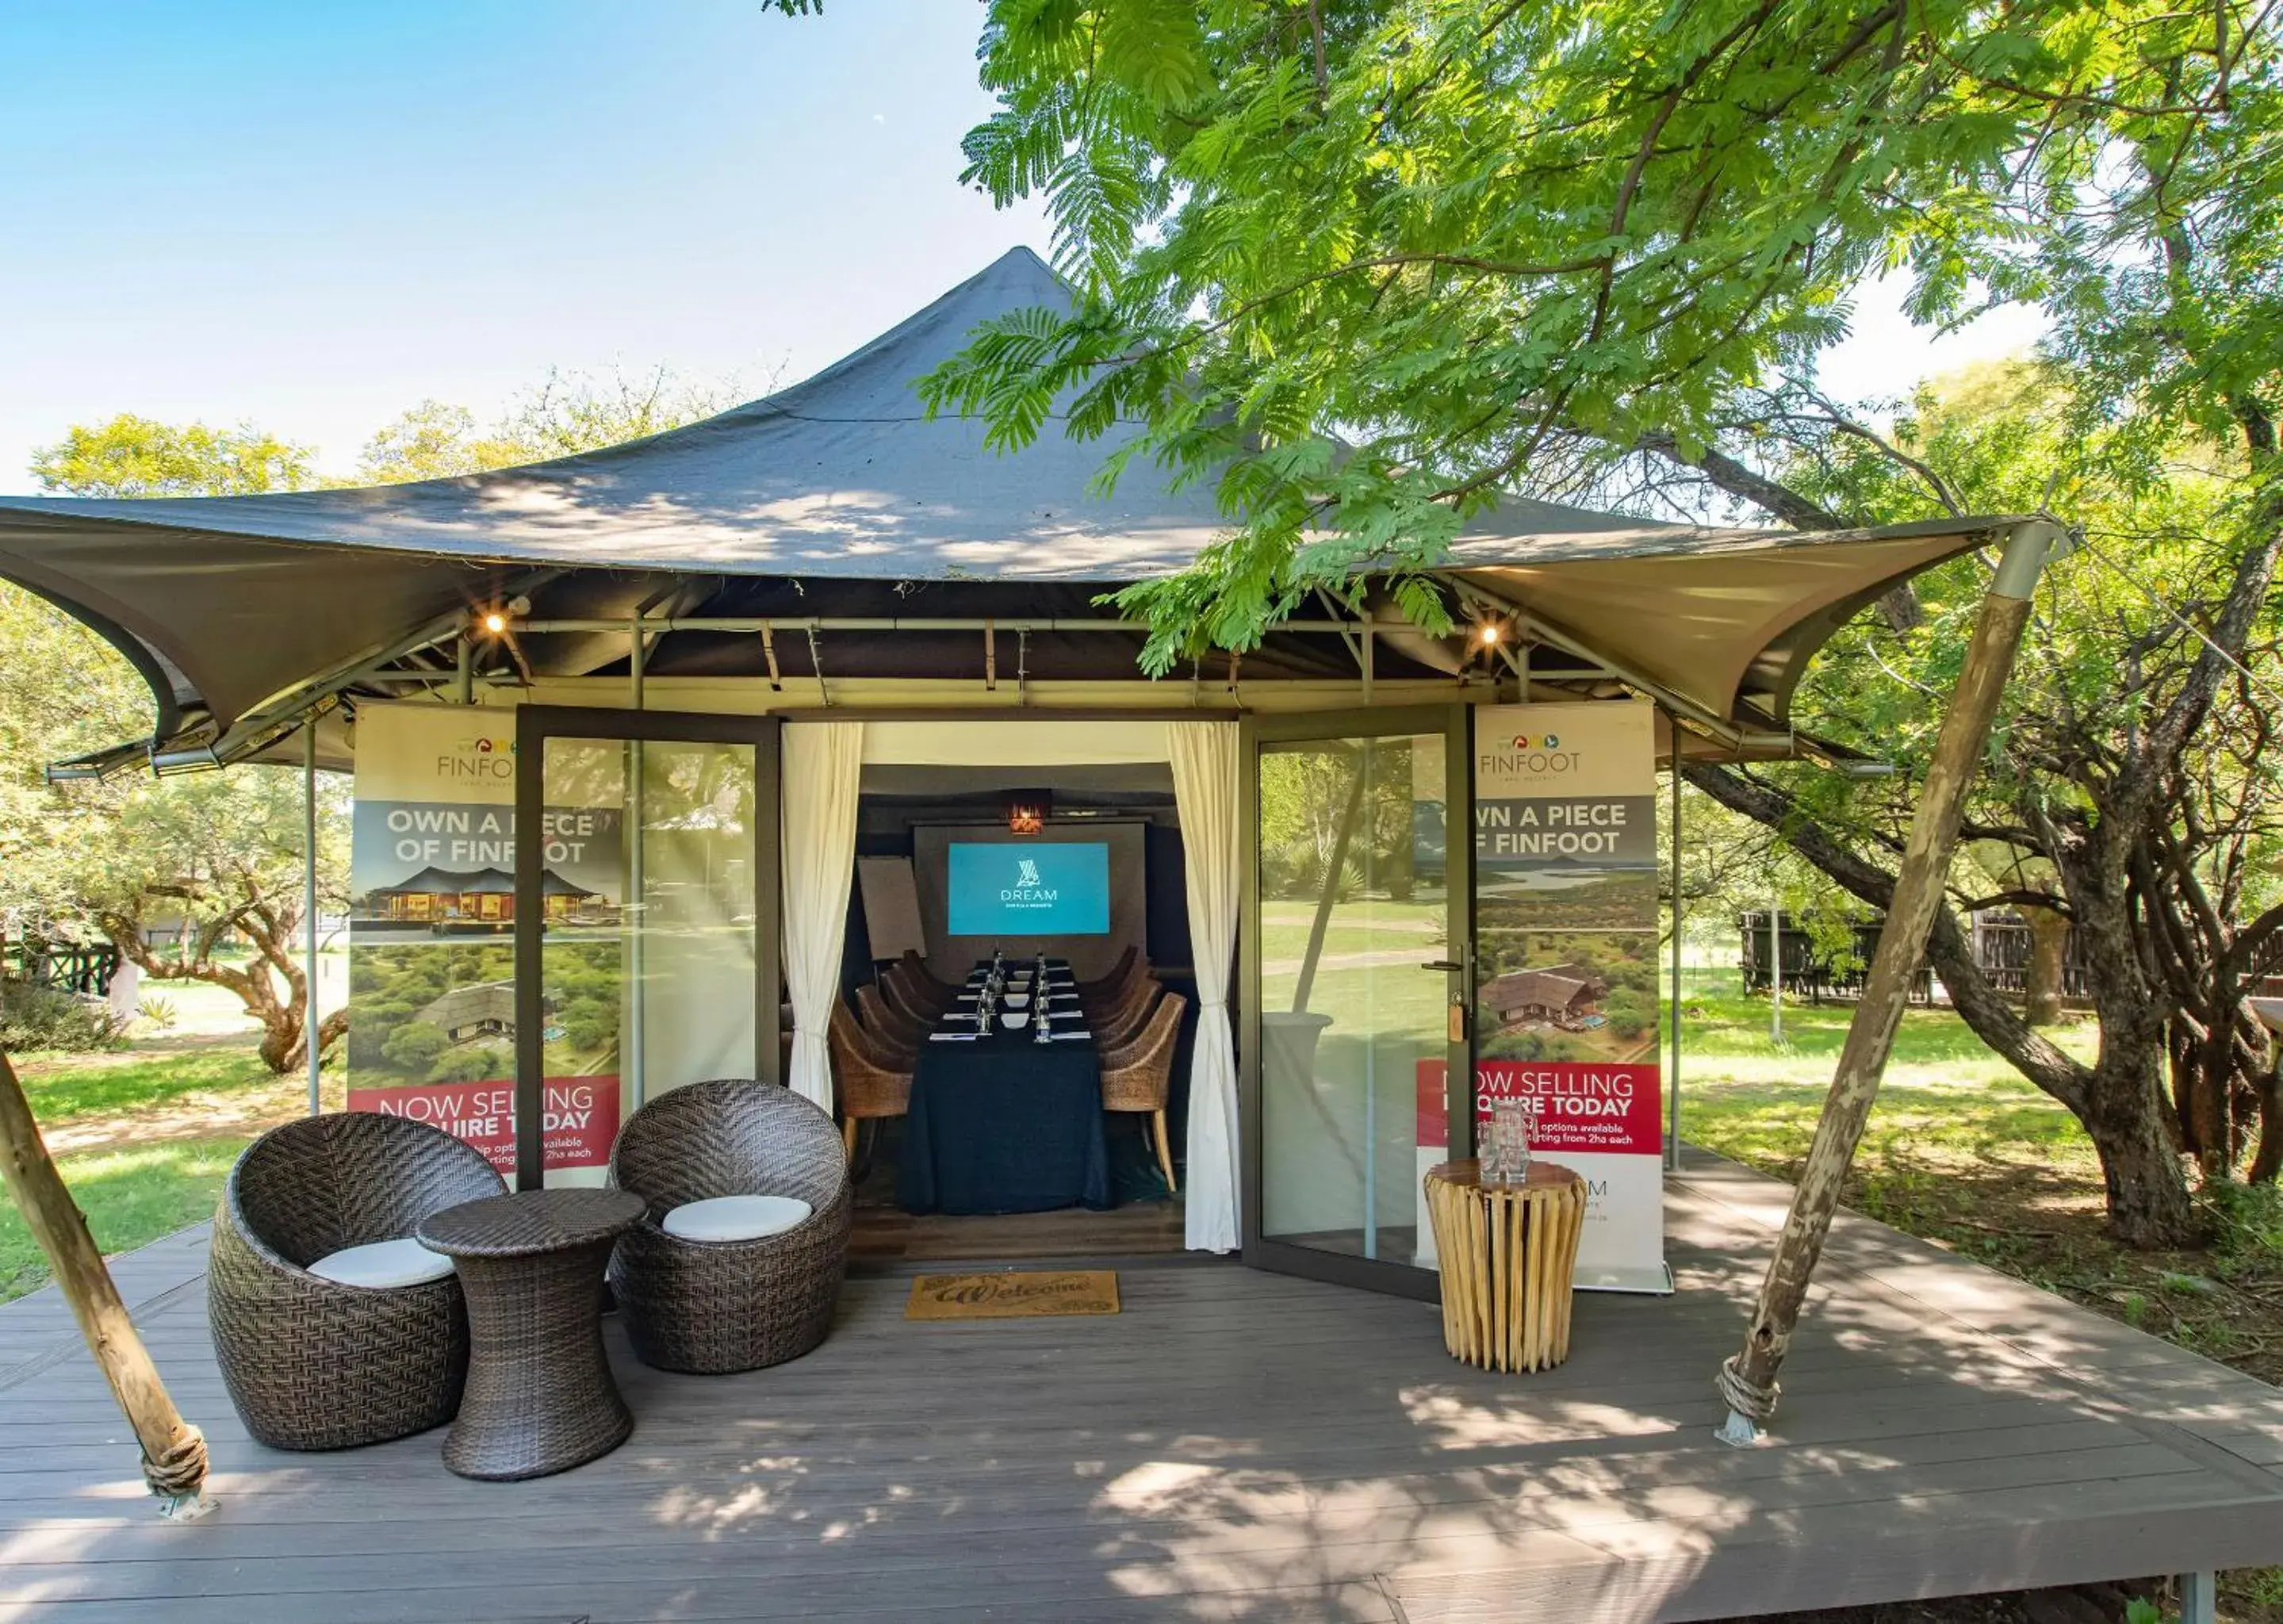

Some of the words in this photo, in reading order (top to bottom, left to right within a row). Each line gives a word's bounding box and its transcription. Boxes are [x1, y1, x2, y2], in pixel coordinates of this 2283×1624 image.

[438, 756, 512, 778] FINFO
[1481, 753, 1580, 774] FINFOOT
[387, 810, 469, 833] OWN
[478, 813, 501, 834] A
[1519, 806, 1539, 826] A
[1549, 804, 1626, 826] PIECE
[396, 838, 440, 862] OF
[451, 840, 585, 864] FINFOT
[1496, 832, 1620, 853] FINFOOT
[1001, 890, 1057, 901] DREAM
[1521, 1071, 1634, 1096] SELLING
[380, 1094, 464, 1121] NOW
[473, 1086, 593, 1116] SELING
[1552, 1097, 1633, 1116] TODAY
[506, 1111, 592, 1134] TDAY
[1541, 1122, 1577, 1134] options
[1580, 1122, 1623, 1134] available
[543, 1136, 582, 1148] vailable
[1563, 1132, 1586, 1143] from
[1588, 1133, 1607, 1143] 2ha
[1609, 1135, 1633, 1144] each
[567, 1147, 592, 1158] each
